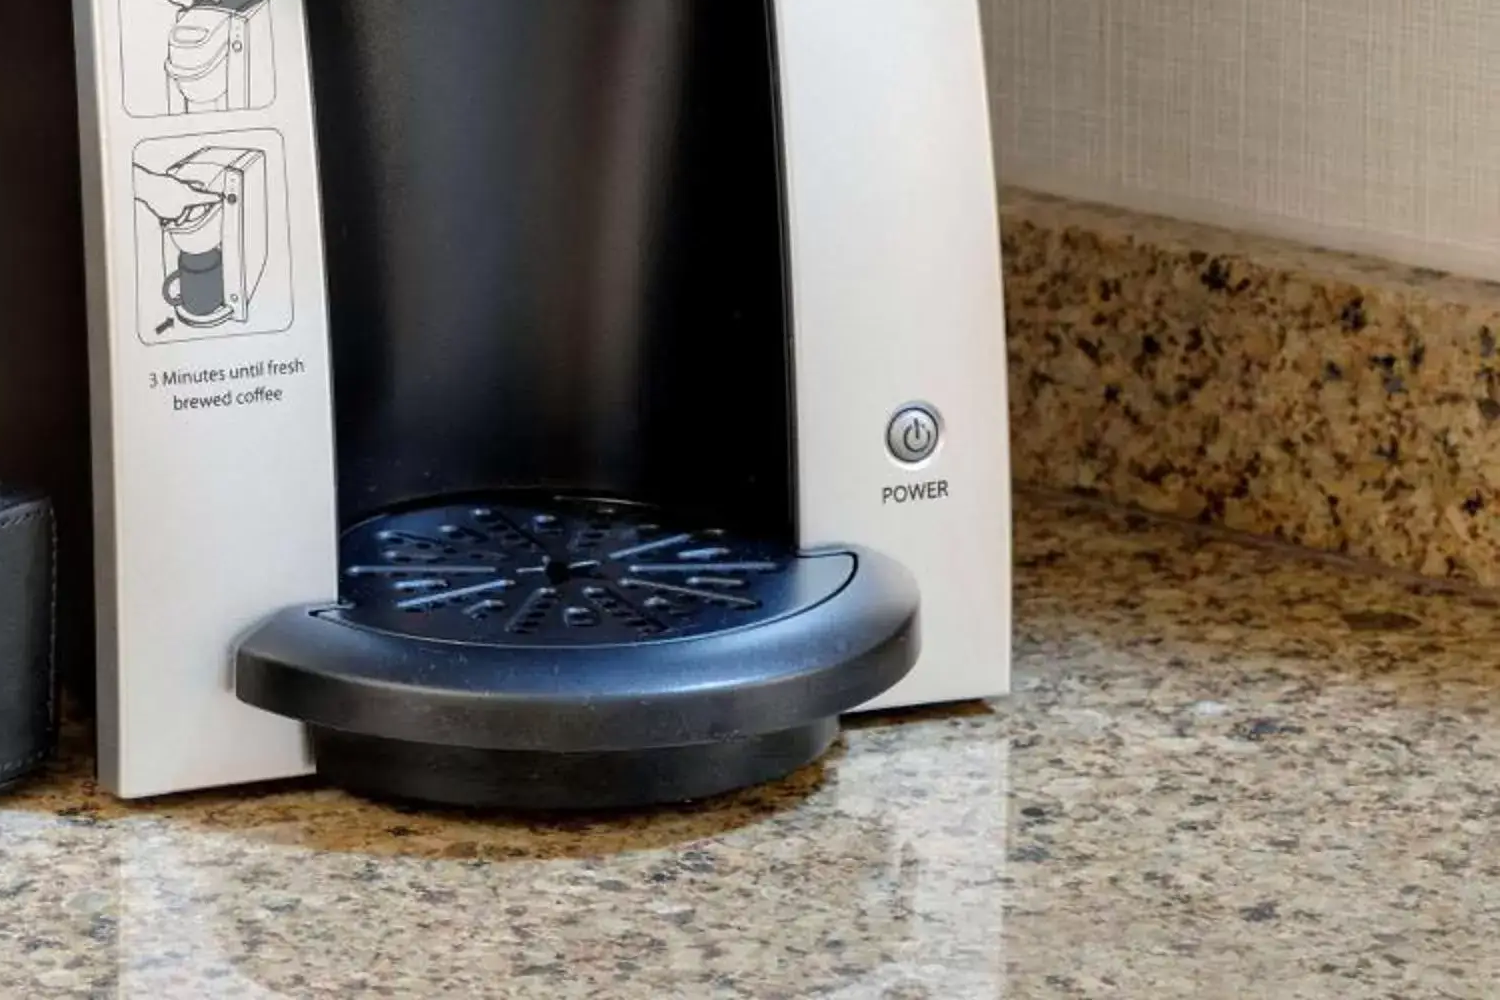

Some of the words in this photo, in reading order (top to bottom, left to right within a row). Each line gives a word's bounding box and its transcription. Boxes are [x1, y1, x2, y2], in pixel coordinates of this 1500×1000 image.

[148, 371, 158, 389] 3
[162, 367, 225, 386] Minutes
[229, 360, 264, 380] until
[267, 358, 305, 375] fresh
[173, 390, 233, 410] brewed
[236, 387, 283, 405] coffee
[881, 480, 949, 504] POWER
